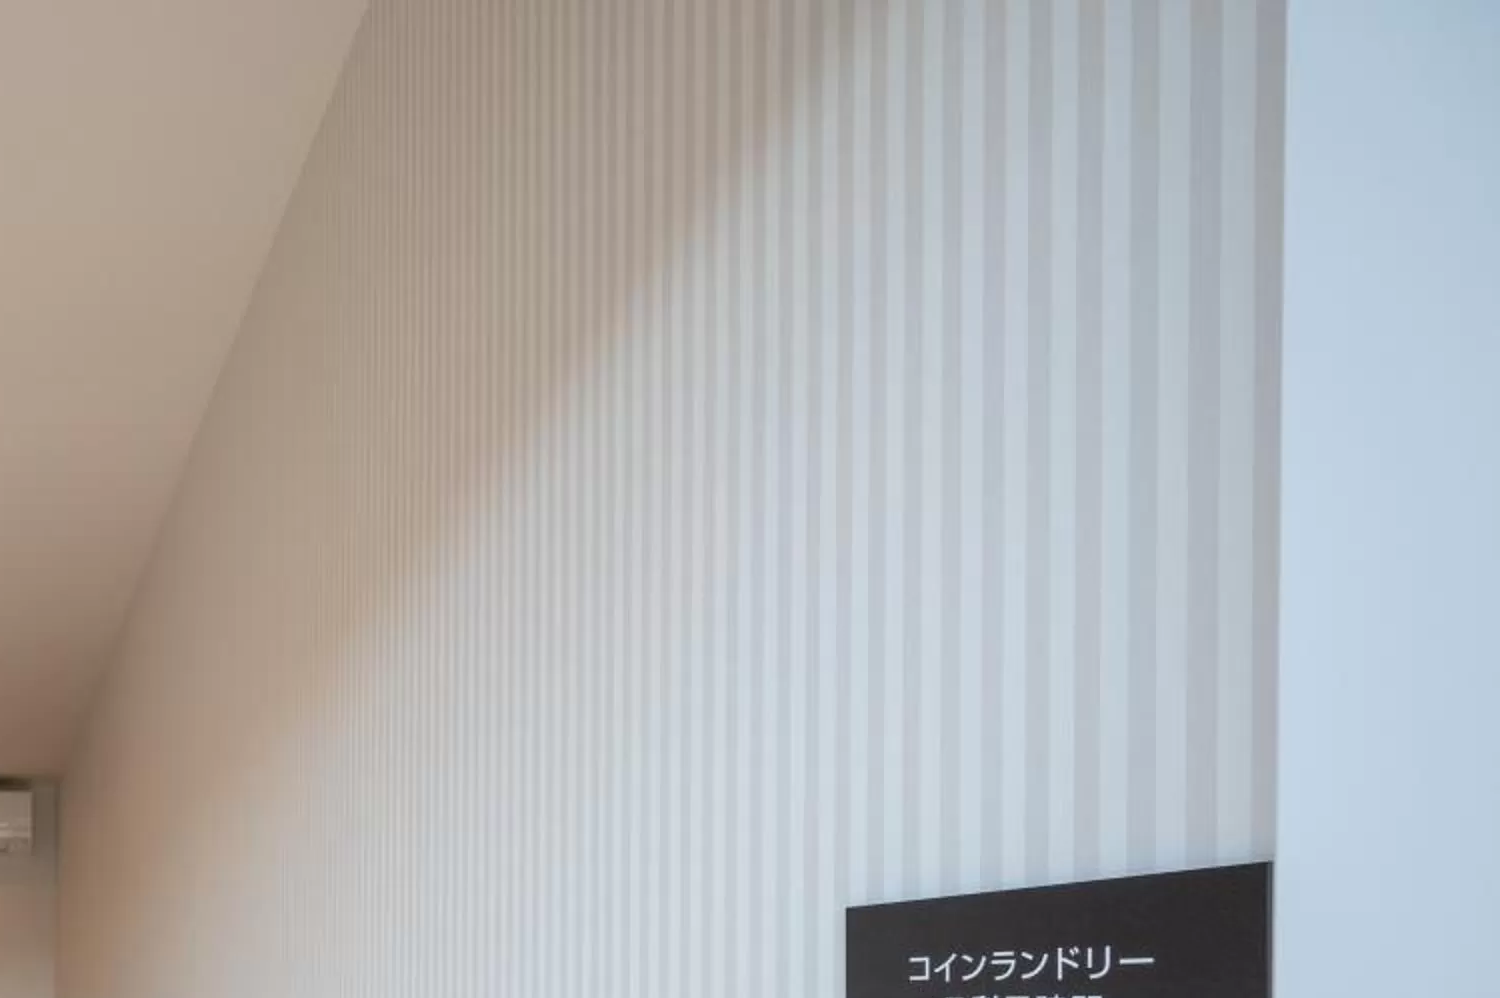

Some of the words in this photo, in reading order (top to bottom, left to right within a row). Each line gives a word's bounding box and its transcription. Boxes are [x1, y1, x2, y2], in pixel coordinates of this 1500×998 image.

[908, 945, 1155, 983] コインランドリー
